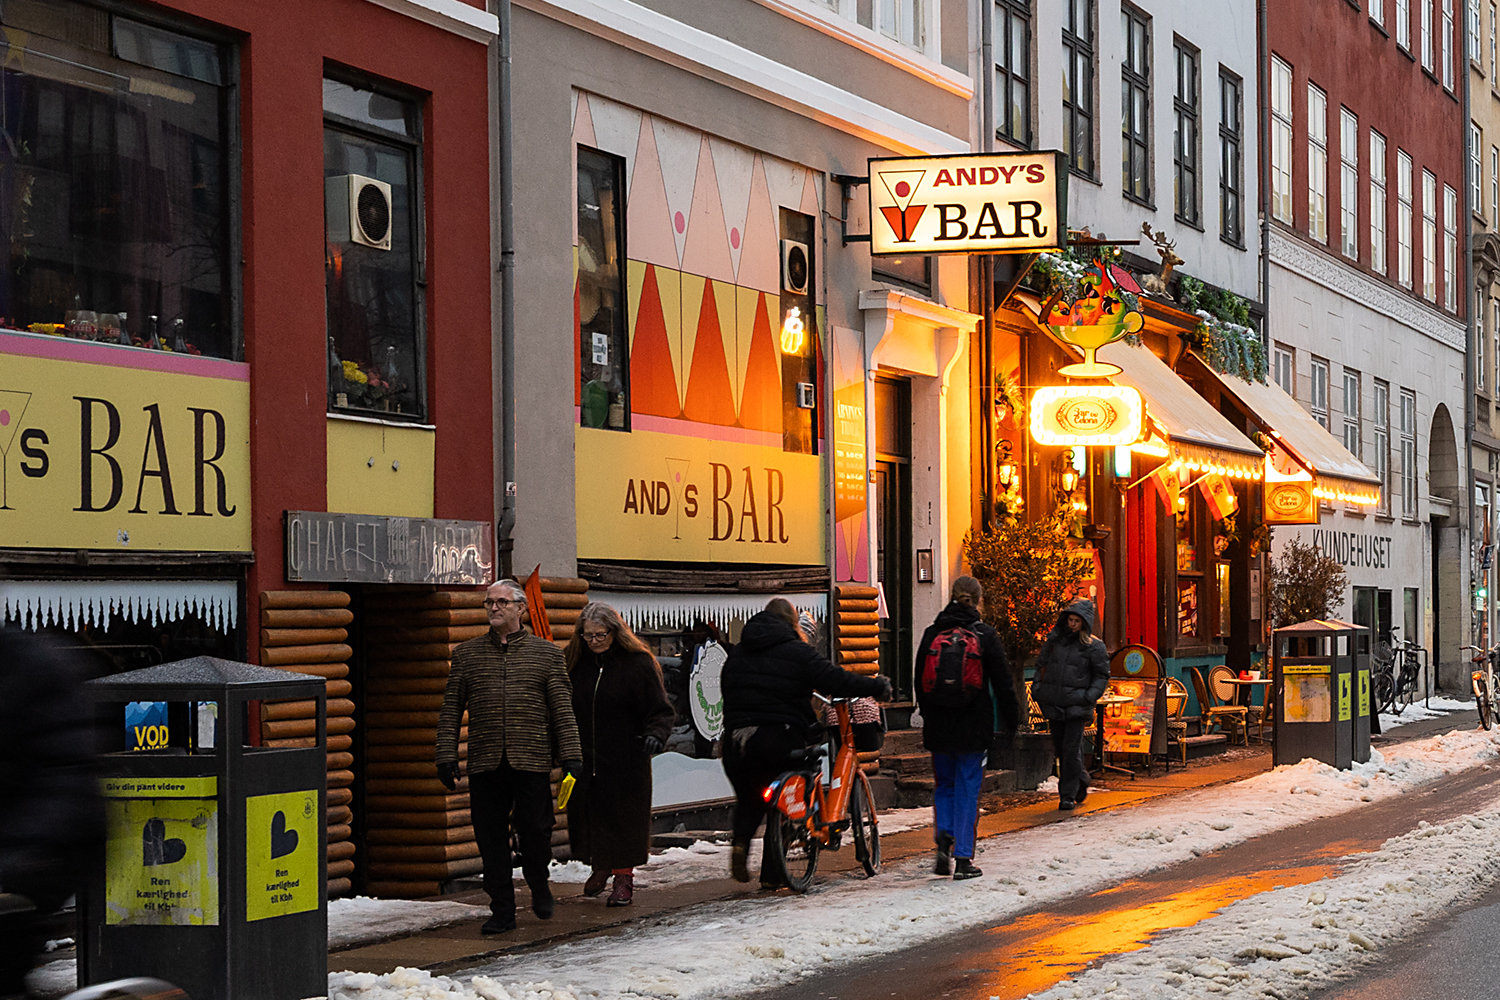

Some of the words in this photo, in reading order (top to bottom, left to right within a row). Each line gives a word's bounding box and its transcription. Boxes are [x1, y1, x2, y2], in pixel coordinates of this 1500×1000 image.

[932, 164, 1046, 187] ANDY'S
[934, 200, 1048, 242] BAR
[72, 396, 236, 517] BAR
[708, 462, 789, 544] BAR
[291, 518, 381, 573] CHALET
[1313, 528, 1392, 569] KVINDEHUSET
[134, 725, 169, 747] VOD
[137, 783, 156, 792] pant
[151, 877, 170, 886] Ren
[275, 869, 288, 877] Ren
[136, 889, 188, 899] kærlighed
[266, 879, 299, 892] kærlighed
[280, 893, 293, 902] Kbh
[144, 903, 155, 911] til
